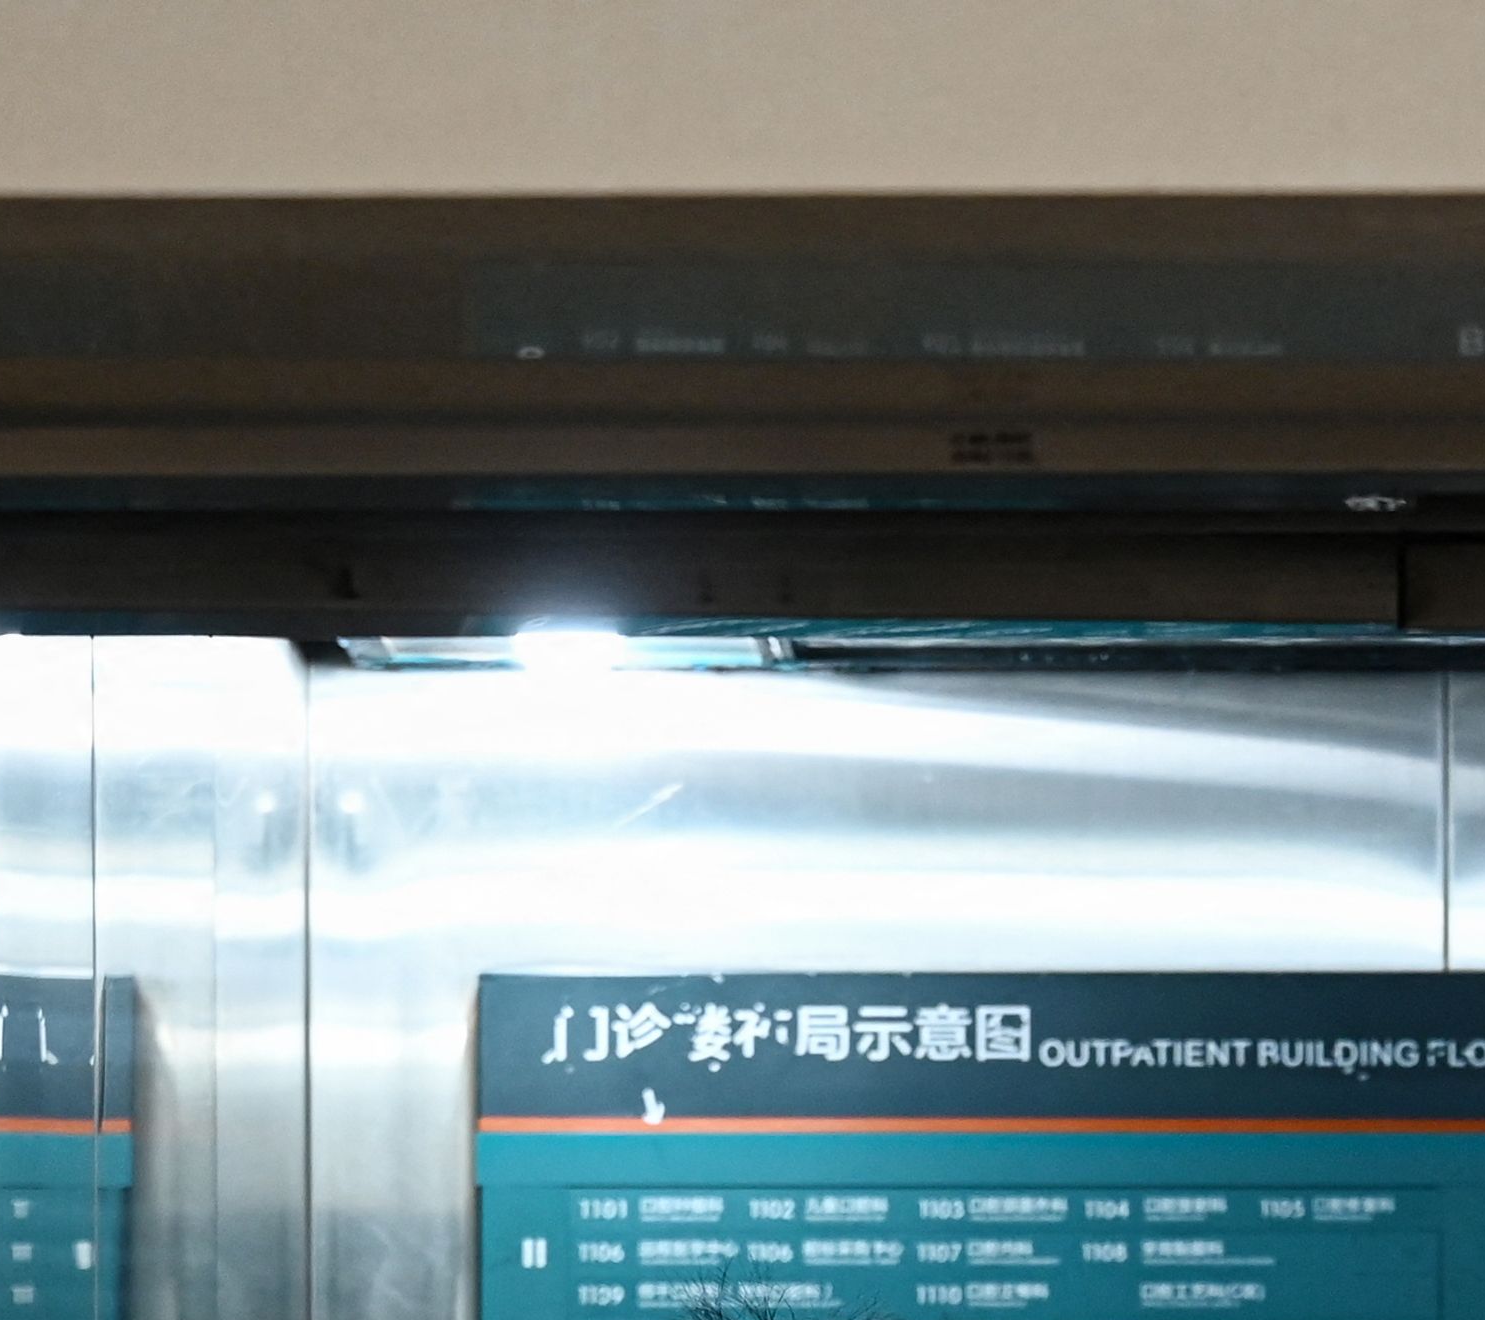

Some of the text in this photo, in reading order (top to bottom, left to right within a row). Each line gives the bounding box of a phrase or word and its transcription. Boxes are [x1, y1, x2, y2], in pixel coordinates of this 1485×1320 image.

[1038, 1039, 1251, 1068] OUTPATIENT
[1257, 1039, 1419, 1074] BUILDING
[579, 1198, 629, 1220] 1101
[748, 1198, 796, 1220] 1102
